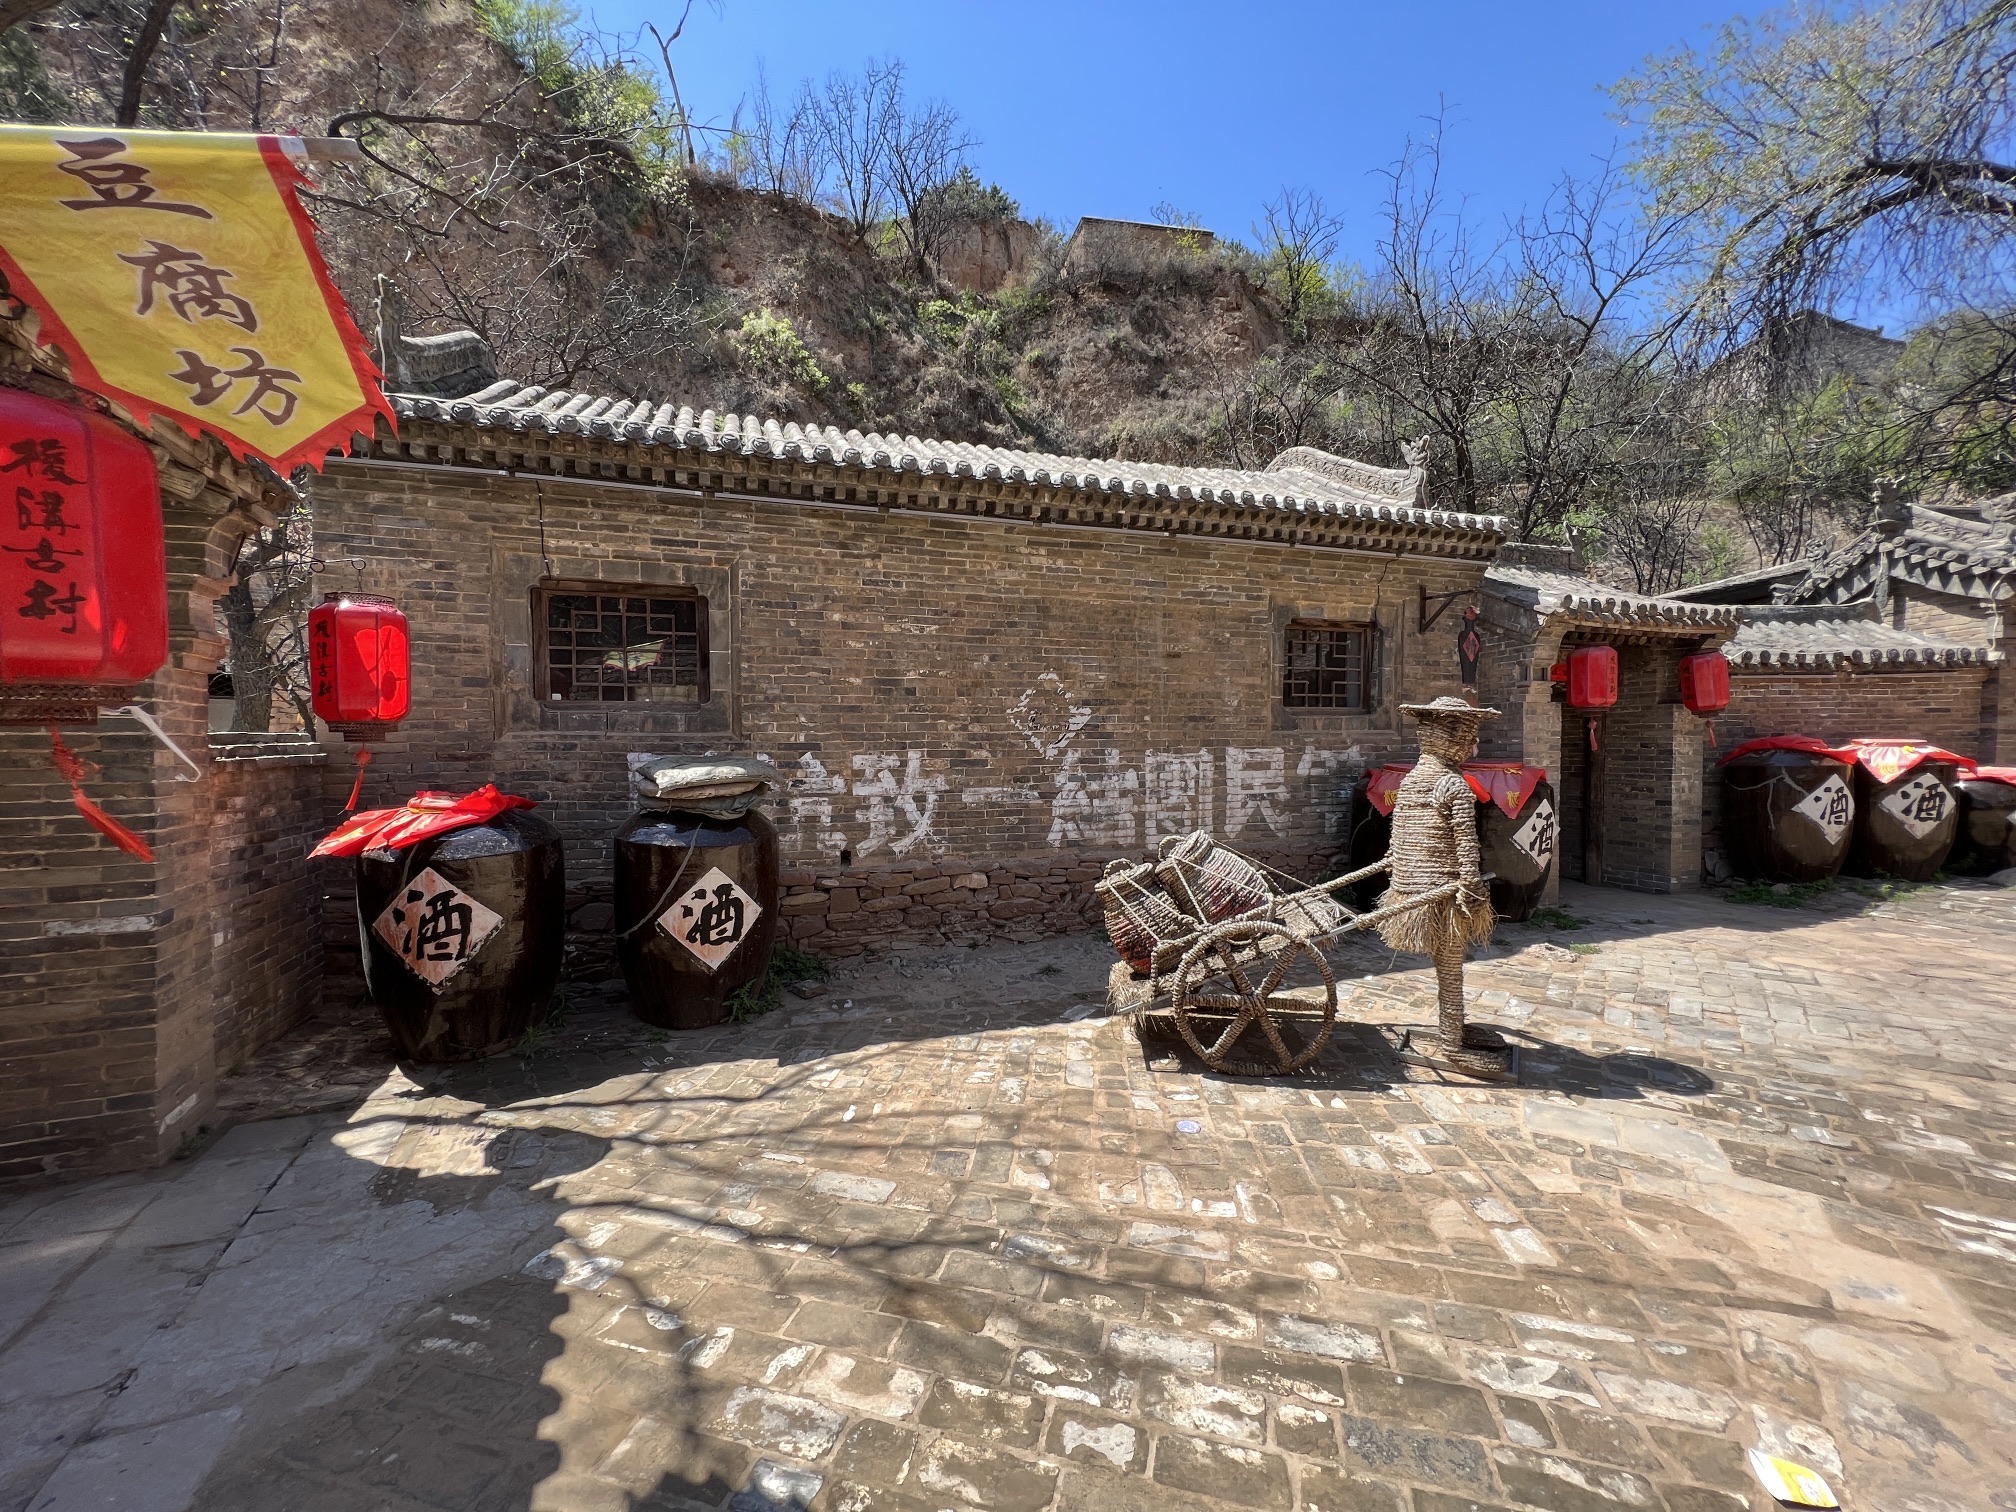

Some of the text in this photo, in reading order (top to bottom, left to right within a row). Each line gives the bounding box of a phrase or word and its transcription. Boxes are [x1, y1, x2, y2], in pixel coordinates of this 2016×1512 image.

[55, 137, 302, 426] 豆腐坊
[1814, 786, 1849, 826] 酒
[1901, 781, 1947, 823] 酒
[1529, 811, 1553, 857] 酒
[393, 889, 473, 962] 酒
[681, 883, 744, 947] 酒
